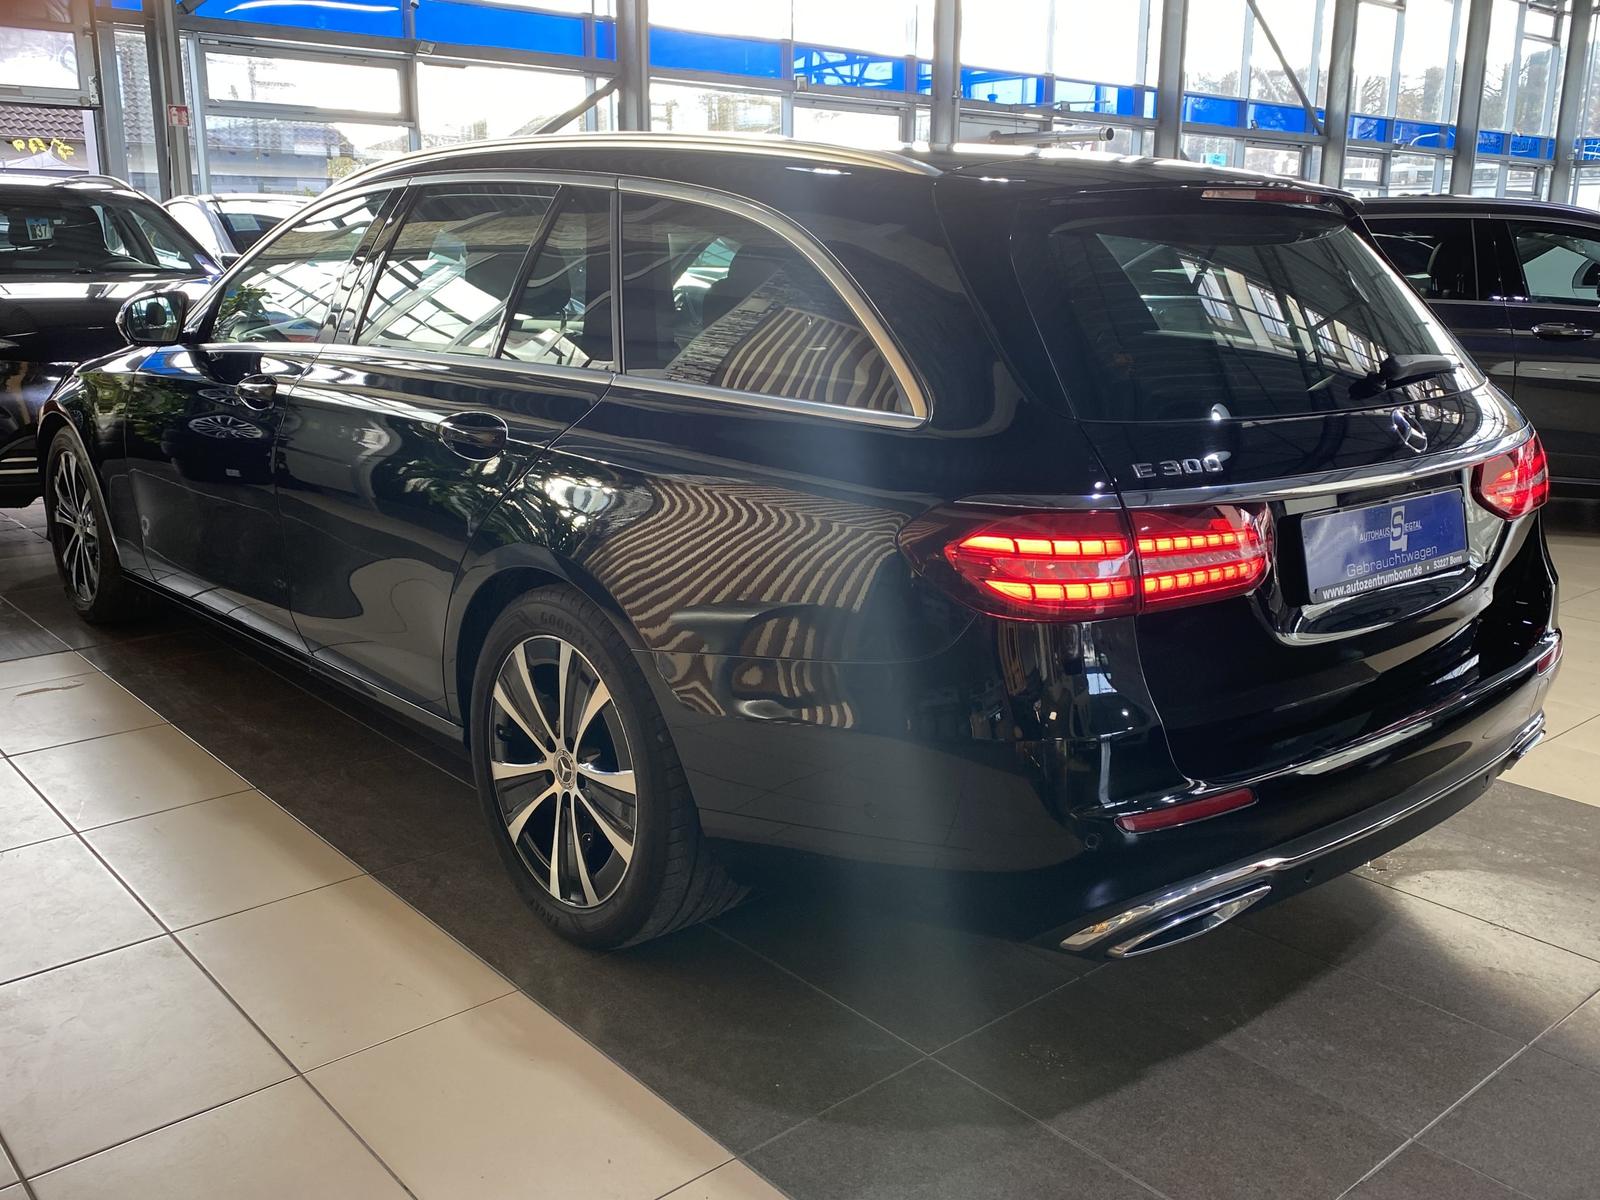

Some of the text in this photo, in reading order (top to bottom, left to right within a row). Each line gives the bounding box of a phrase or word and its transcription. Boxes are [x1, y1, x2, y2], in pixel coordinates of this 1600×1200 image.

[1132, 458, 1223, 478] E 300
[1360, 527, 1391, 543] AUTOHAUS
[1347, 545, 1437, 577] Gebrauchtwagen
[1323, 555, 1462, 599] www.autozentrumbonn.de 53227 Bonn
